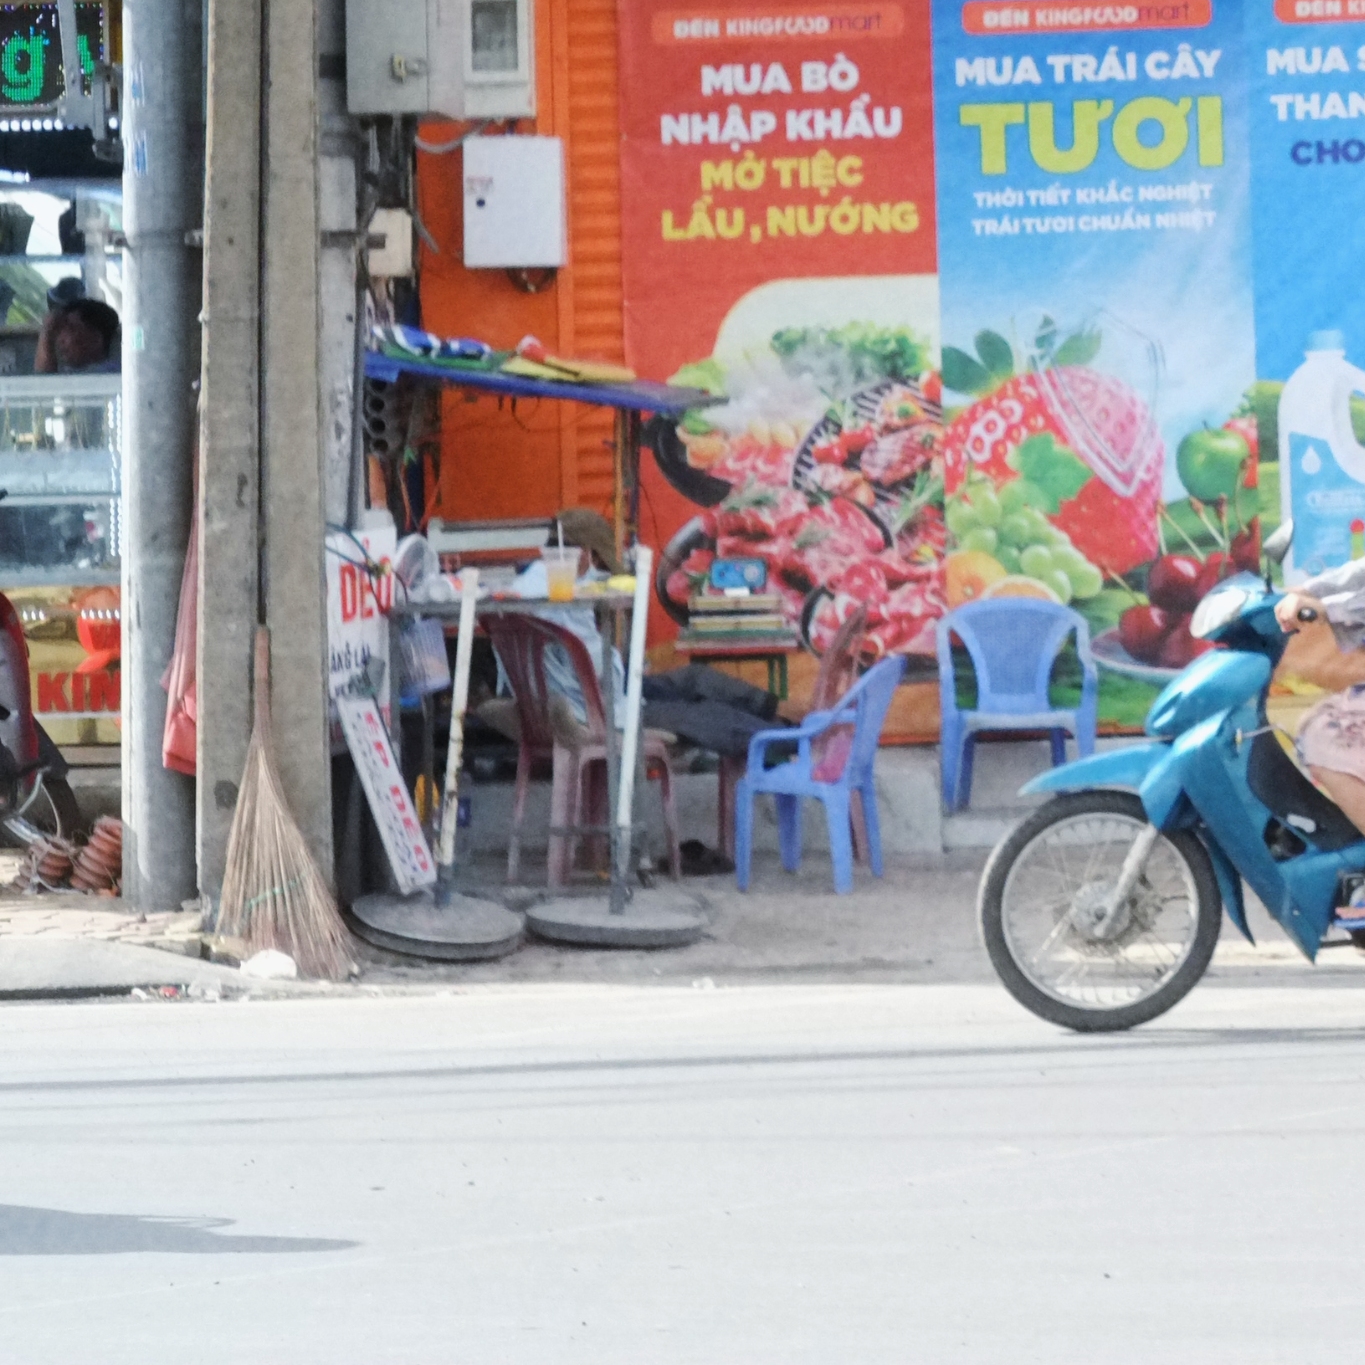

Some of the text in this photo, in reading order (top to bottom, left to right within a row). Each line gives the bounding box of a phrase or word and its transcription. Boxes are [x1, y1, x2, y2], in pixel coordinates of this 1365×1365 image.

[700, 51, 860, 97] MUA BÒ
[955, 42, 1222, 87] MUA TRÁI CÂY
[1266, 44, 1350, 76] MUA
[660, 103, 777, 153] NHẬP
[959, 94, 1225, 176] TƯƠI
[700, 149, 864, 197] MỞ TIỆC
[766, 196, 920, 238] NƯỚNG
